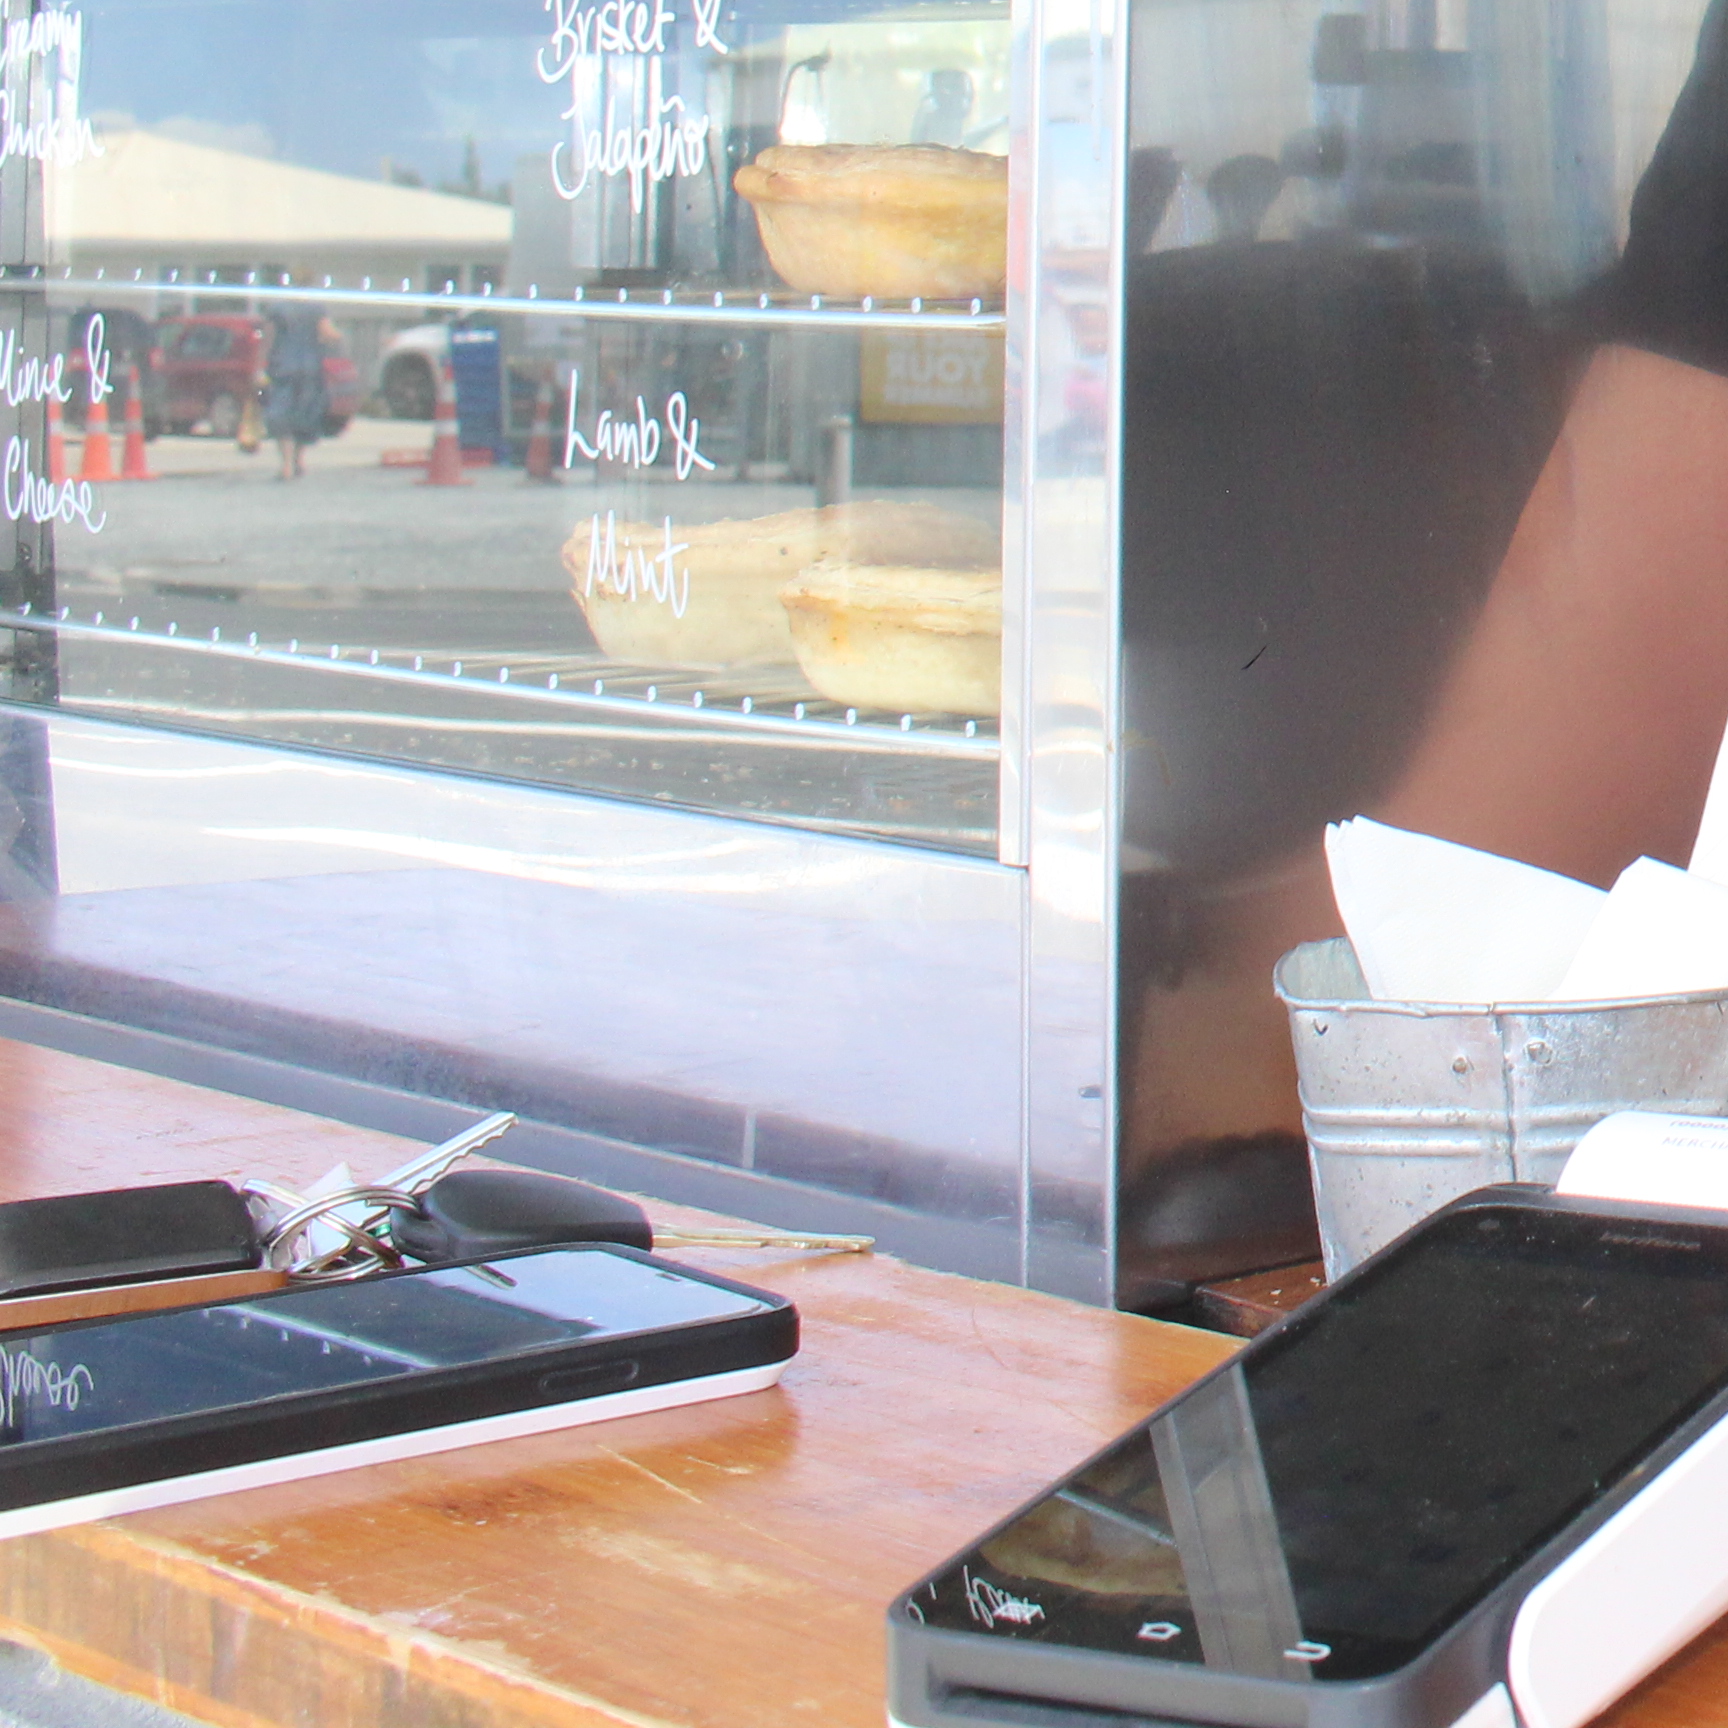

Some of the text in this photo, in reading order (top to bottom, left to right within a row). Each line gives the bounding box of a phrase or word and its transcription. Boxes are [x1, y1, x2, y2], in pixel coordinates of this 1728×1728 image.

[87, 313, 114, 404] &
[564, 368, 716, 480] Lamb &
[4, 435, 107, 534] Cheese
[584, 509, 689, 619] Mint
